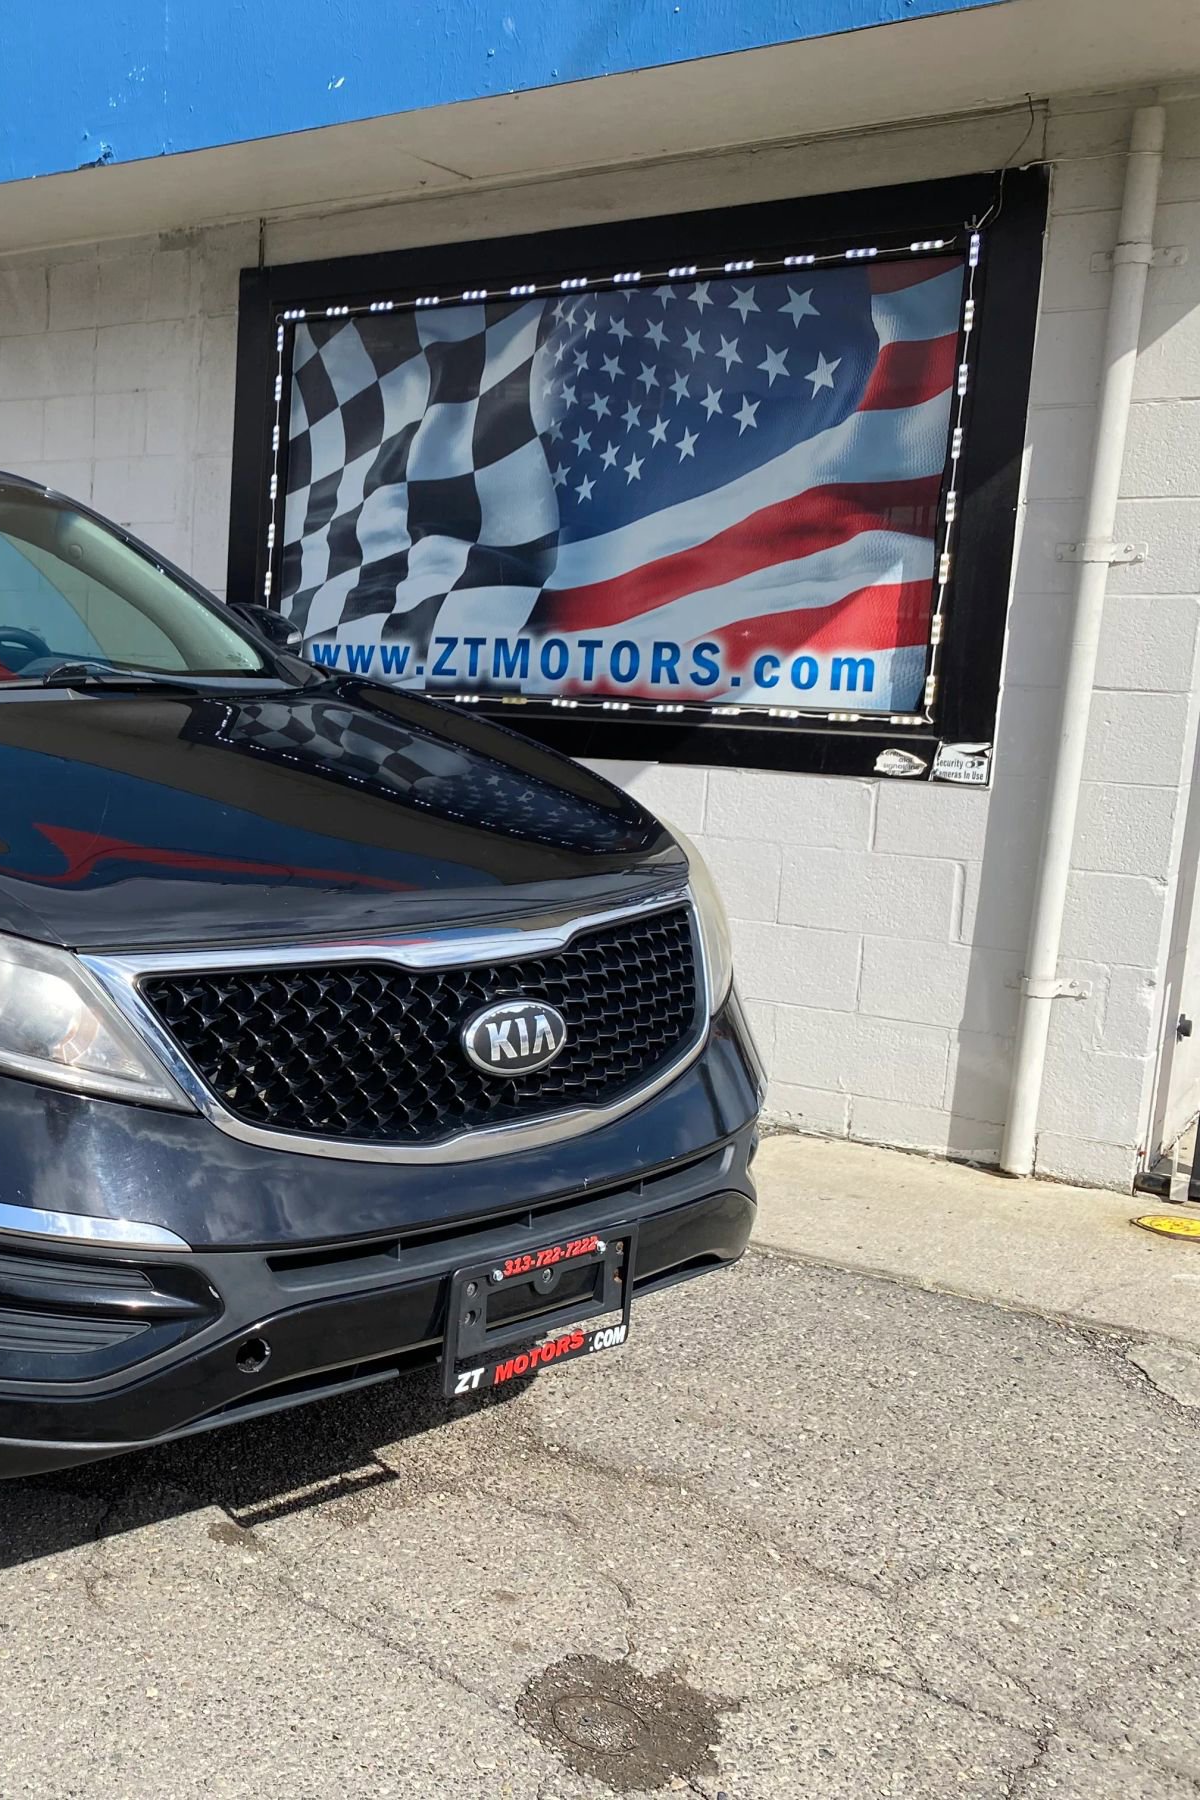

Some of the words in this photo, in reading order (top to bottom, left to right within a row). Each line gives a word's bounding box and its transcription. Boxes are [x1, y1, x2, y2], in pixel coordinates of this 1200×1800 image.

[312, 636, 877, 693] www.ZTMOTORS.com
[484, 1014, 556, 1061] KIA
[502, 1235, 599, 1277] 313-722-7222
[454, 1367, 485, 1395] ZT
[493, 1328, 585, 1385] MOTORS
